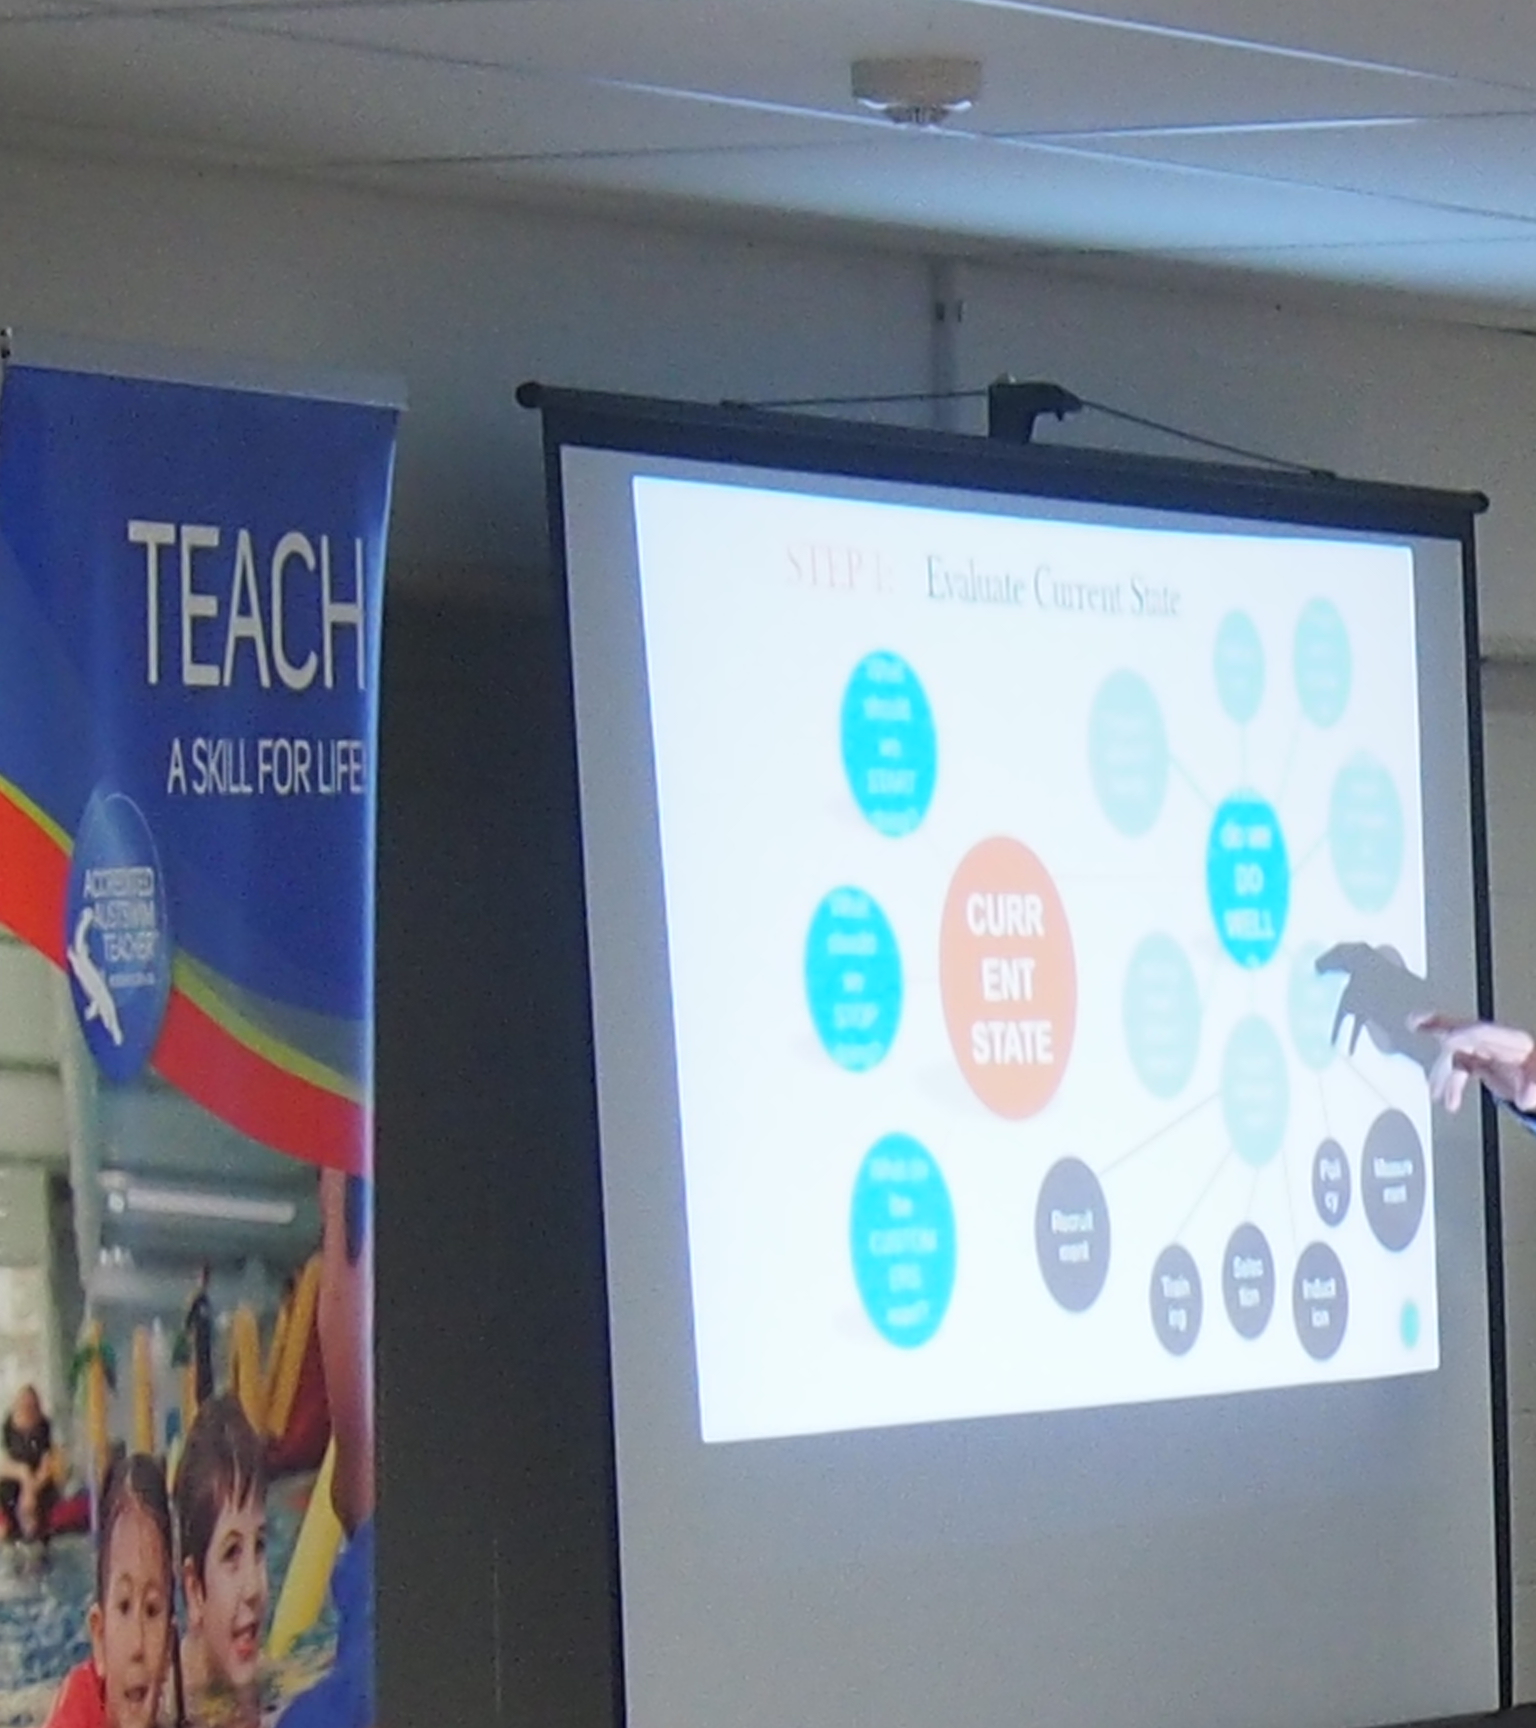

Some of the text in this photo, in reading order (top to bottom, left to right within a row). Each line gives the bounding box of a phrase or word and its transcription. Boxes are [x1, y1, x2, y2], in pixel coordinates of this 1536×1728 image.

[127, 520, 366, 690] TEACH
[925, 552, 1027, 607] Evaluate
[1033, 562, 1124, 615] Current
[1129, 571, 1182, 618] State
[168, 738, 187, 795] A
[192, 740, 252, 796] SKILL
[258, 740, 310, 795] FOR
[1234, 863, 1264, 897] DO
[966, 892, 1045, 936] CURR
[1224, 906, 1276, 940] WELL
[983, 957, 1036, 1001] ENT
[971, 1020, 1054, 1066] STATE
